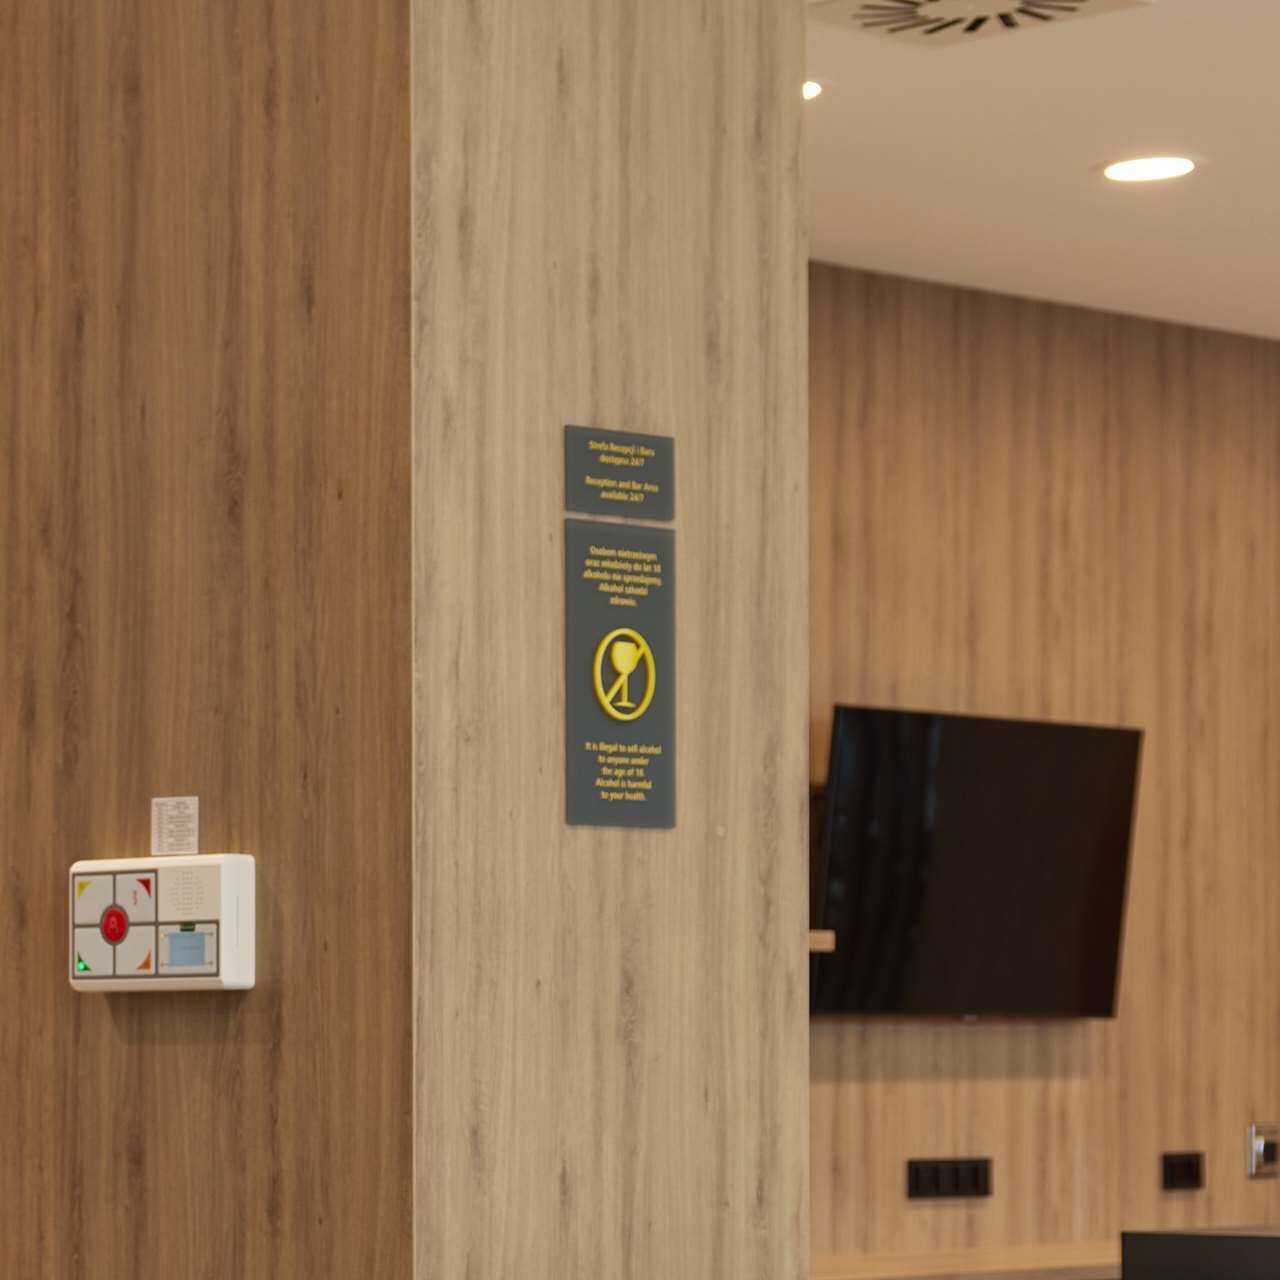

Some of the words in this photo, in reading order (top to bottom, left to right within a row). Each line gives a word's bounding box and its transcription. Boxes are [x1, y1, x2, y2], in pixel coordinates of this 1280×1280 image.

[586, 476, 617, 488] Reception
[618, 478, 630, 489] and
[631, 480, 642, 490] Bar
[600, 489, 628, 500] available
[630, 491, 644, 503] 24/7
[598, 742, 618, 754] illegal
[627, 744, 638, 753] sell
[640, 744, 662, 755] alcohol
[607, 756, 630, 766] anyone
[631, 756, 649, 766] under
[602, 766, 613, 776] the
[614, 768, 626, 778] age
[596, 778, 620, 788] Alcohol
[610, 792, 624, 802] your
